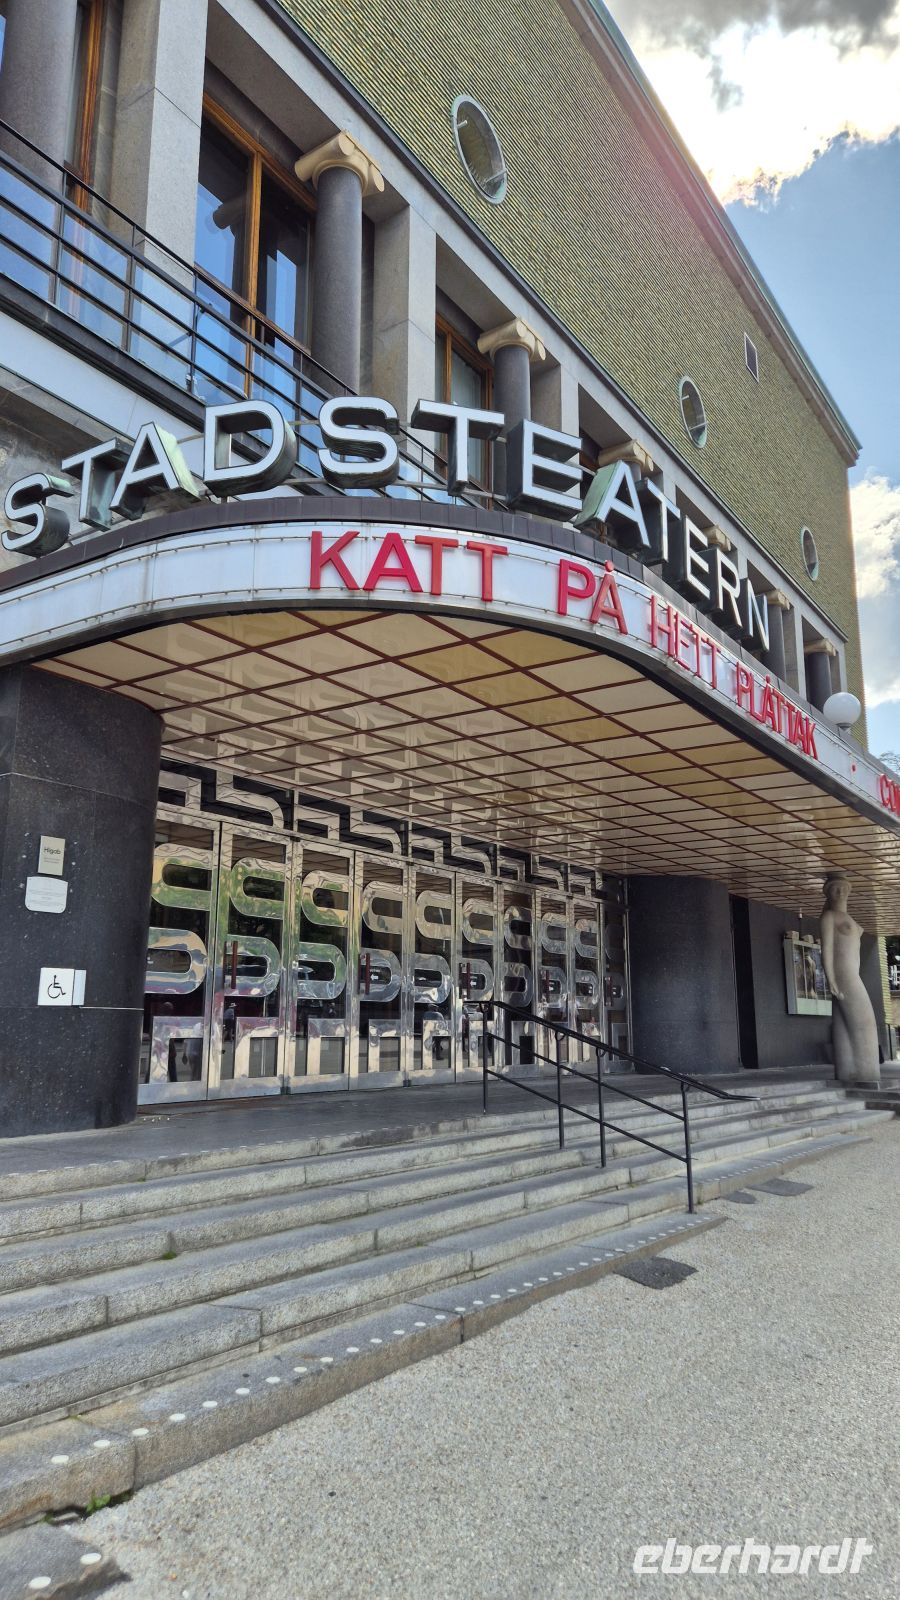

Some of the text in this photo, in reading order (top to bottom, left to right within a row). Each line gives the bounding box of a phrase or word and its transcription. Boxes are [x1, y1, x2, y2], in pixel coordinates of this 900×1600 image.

[1, 396, 770, 652] STADSTEATERN
[309, 530, 508, 602] KATT
[557, 560, 628, 635] PÅ
[650, 595, 721, 690] HETT
[735, 661, 818, 760] PLÅTTAK
